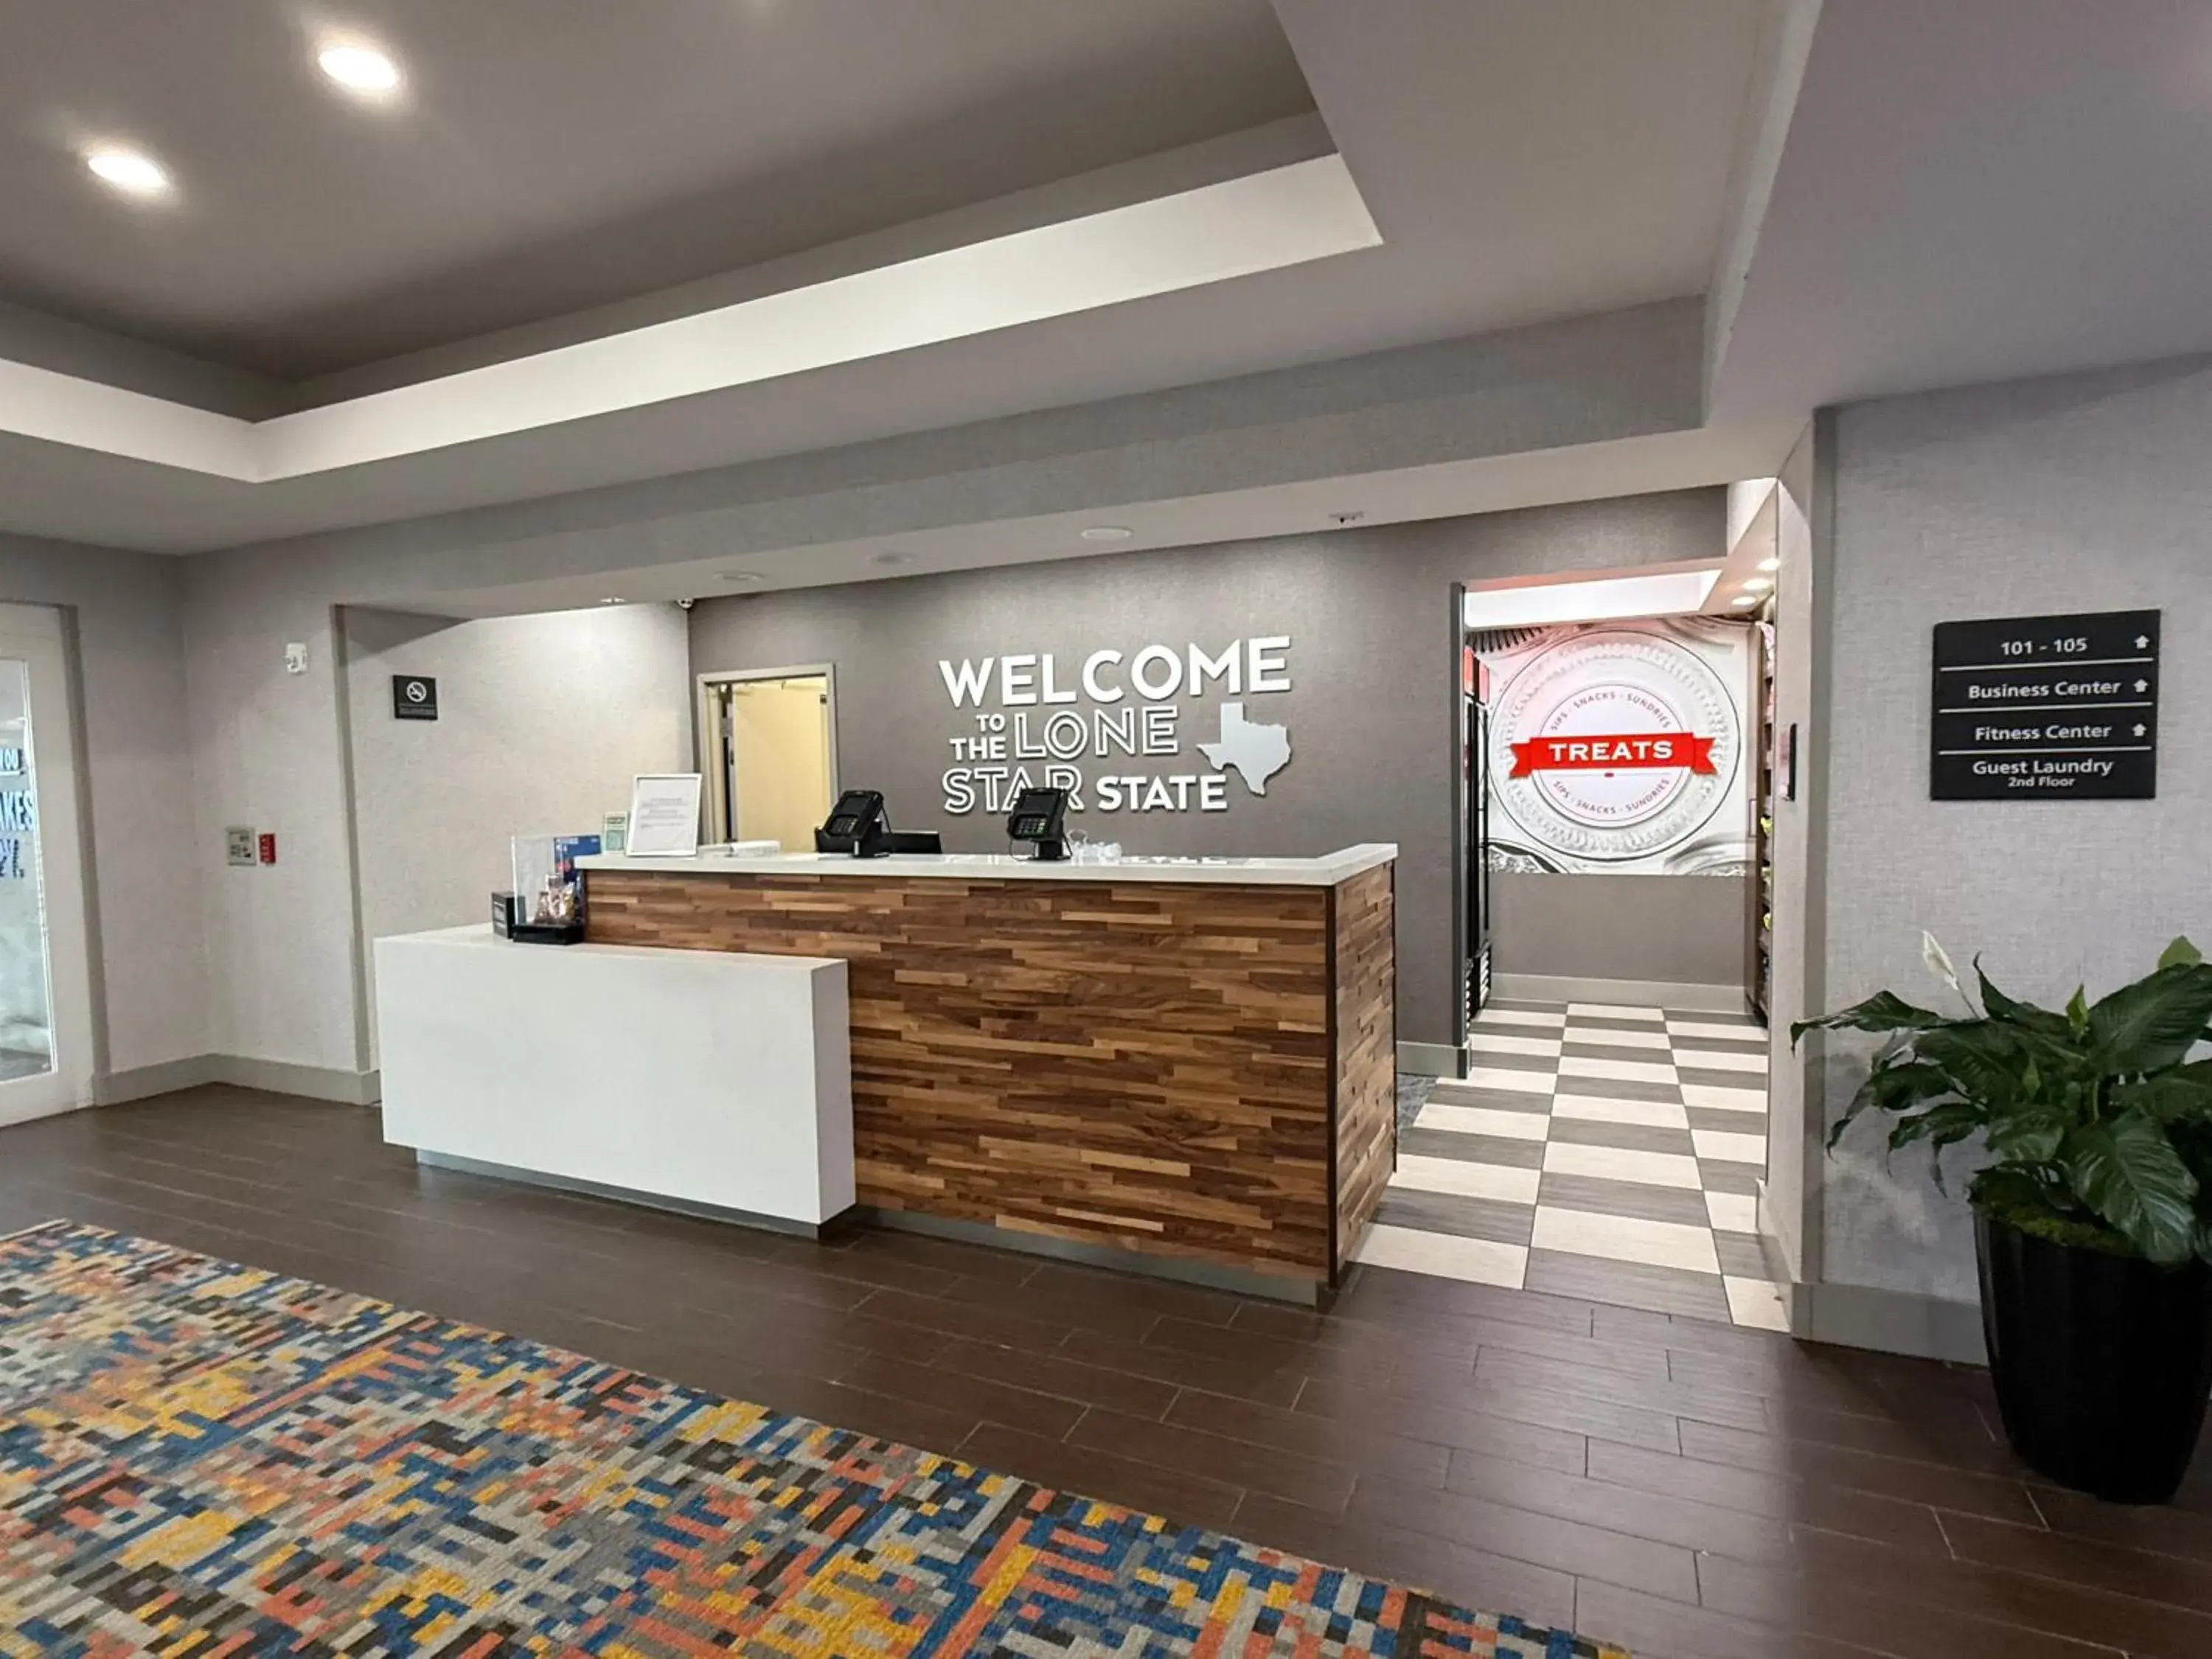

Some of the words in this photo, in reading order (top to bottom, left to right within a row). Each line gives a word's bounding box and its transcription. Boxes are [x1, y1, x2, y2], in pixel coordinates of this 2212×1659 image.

[2000, 640, 2033, 655] 101
[2053, 637, 2088, 653] 105
[939, 636, 1291, 708] WELCOME
[1968, 683, 2049, 699] Business
[2055, 679, 2121, 696] Center
[1551, 712, 1568, 731] SIPS
[1573, 692, 1616, 709] SNACKS
[1627, 693, 1672, 728] SUNDRIES
[950, 737, 1007, 761] THE
[1015, 705, 1179, 760] LONE
[976, 713, 1006, 732] TO
[1975, 726, 2040, 740] Fitness
[2045, 724, 2112, 739] Center
[1548, 740, 1673, 762] TREATS
[1972, 760, 2028, 774] Guest
[2034, 758, 2114, 776] Laundry
[2008, 776, 2035, 787] 2nd
[2038, 776, 2076, 787] Floor
[1096, 774, 1228, 811] STATE
[1554, 781, 1570, 799] SIPS
[1576, 800, 1616, 814] SNACKS
[1625, 779, 1669, 812] SUNDRIES
